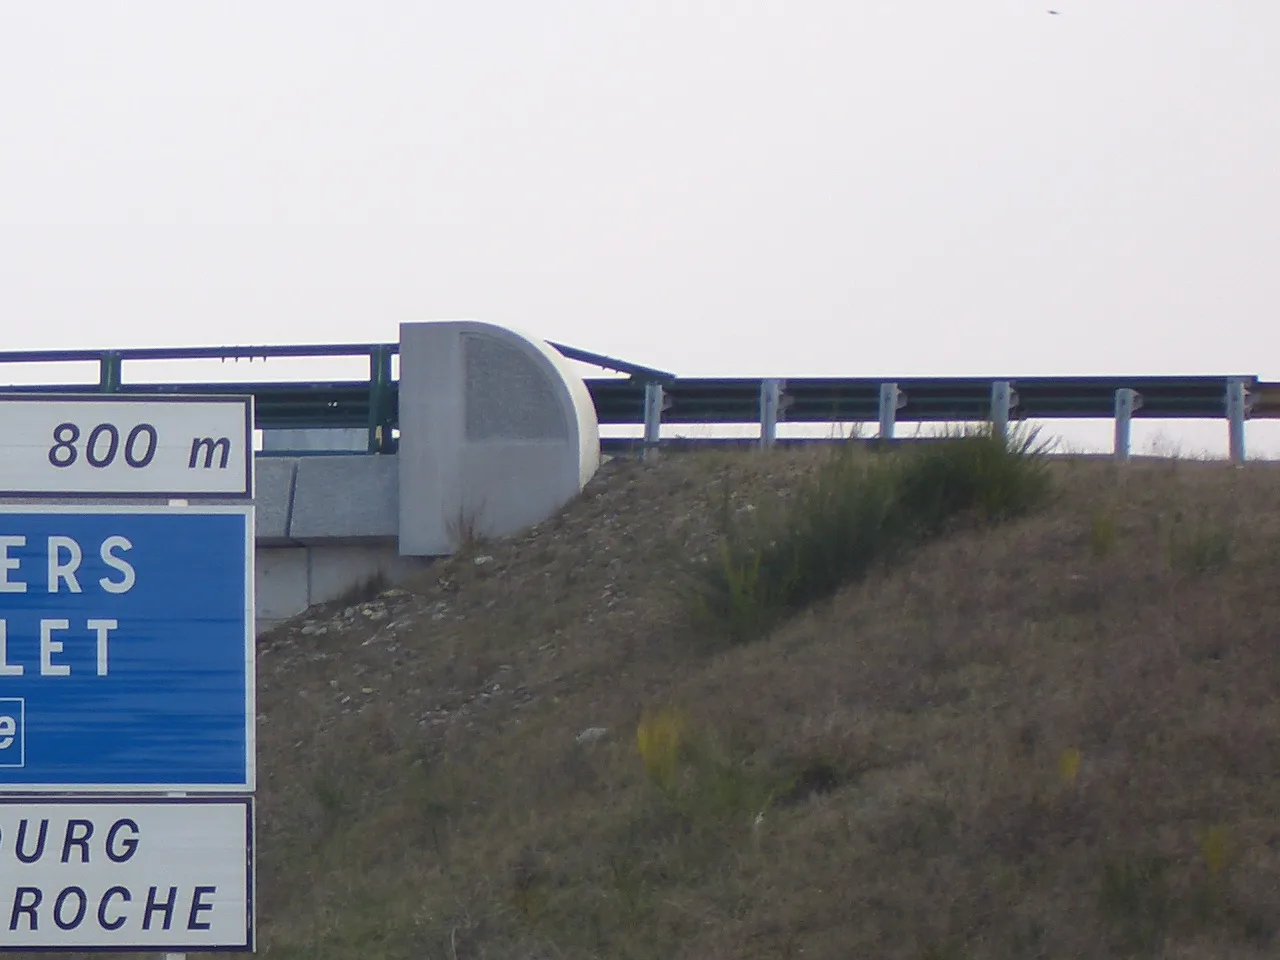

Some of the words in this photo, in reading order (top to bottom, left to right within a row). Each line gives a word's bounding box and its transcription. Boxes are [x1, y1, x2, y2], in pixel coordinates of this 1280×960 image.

[48, 423, 158, 469] 800
[188, 437, 231, 469] m
[8, 885, 217, 931] ROCHE
